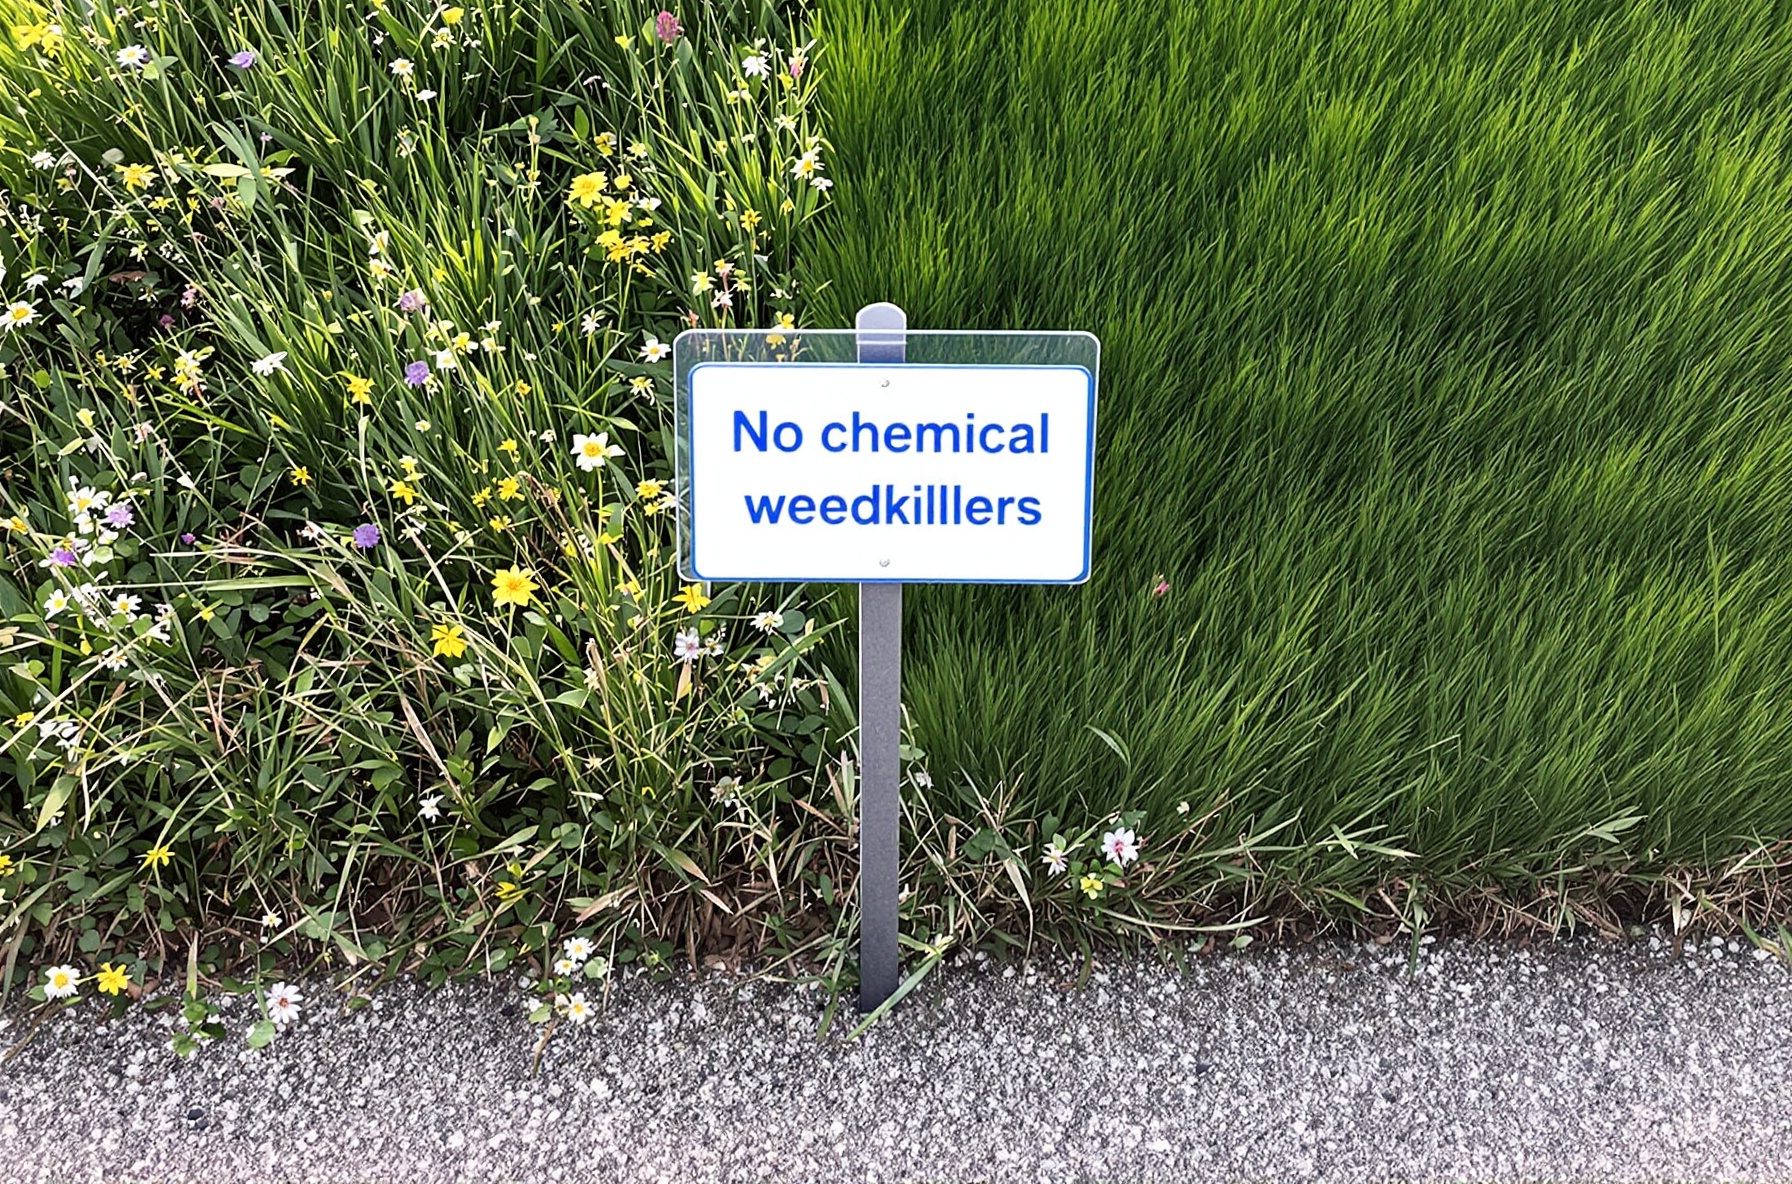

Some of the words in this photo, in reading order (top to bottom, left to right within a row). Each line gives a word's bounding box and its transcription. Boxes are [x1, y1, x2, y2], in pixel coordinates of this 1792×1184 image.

[733, 410, 804, 453] No
[821, 411, 1049, 454] chemical
[744, 484, 1042, 526] weedkilllers
